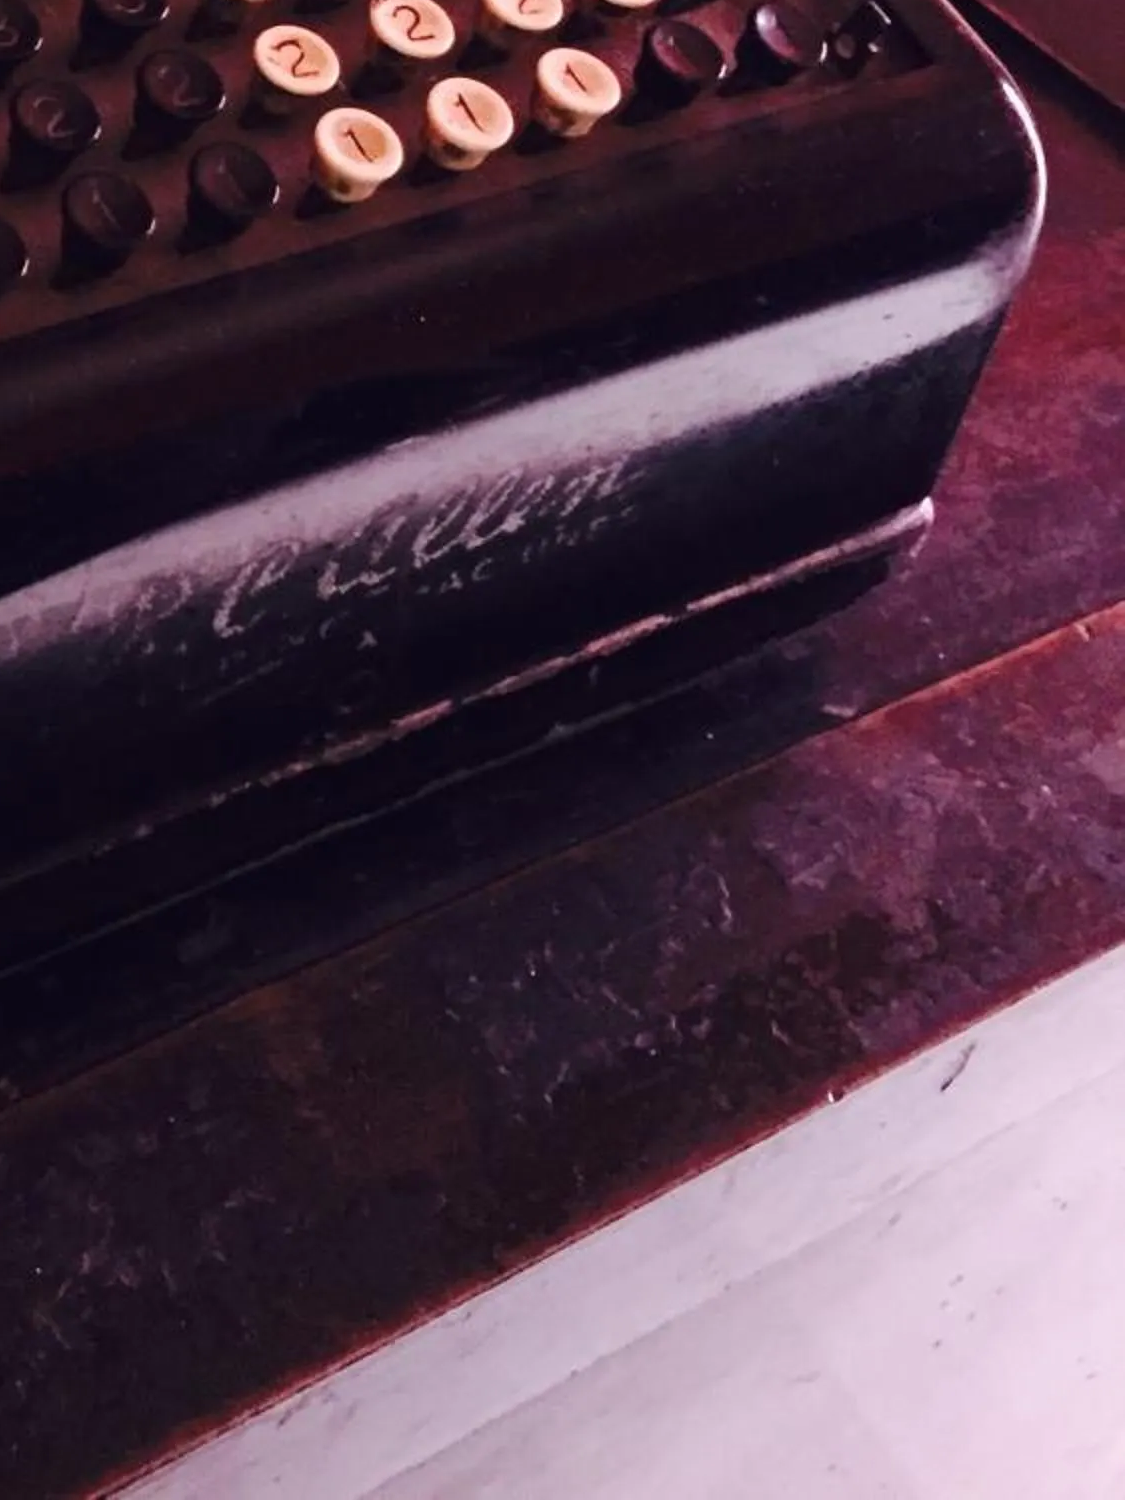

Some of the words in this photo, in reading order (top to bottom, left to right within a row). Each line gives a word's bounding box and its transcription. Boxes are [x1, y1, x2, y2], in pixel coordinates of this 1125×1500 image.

[393, 5, 434, 41] 2
[274, 39, 319, 79] 2
[564, 63, 587, 93] 1
[454, 91, 484, 133] 1
[346, 129, 374, 163] 1
